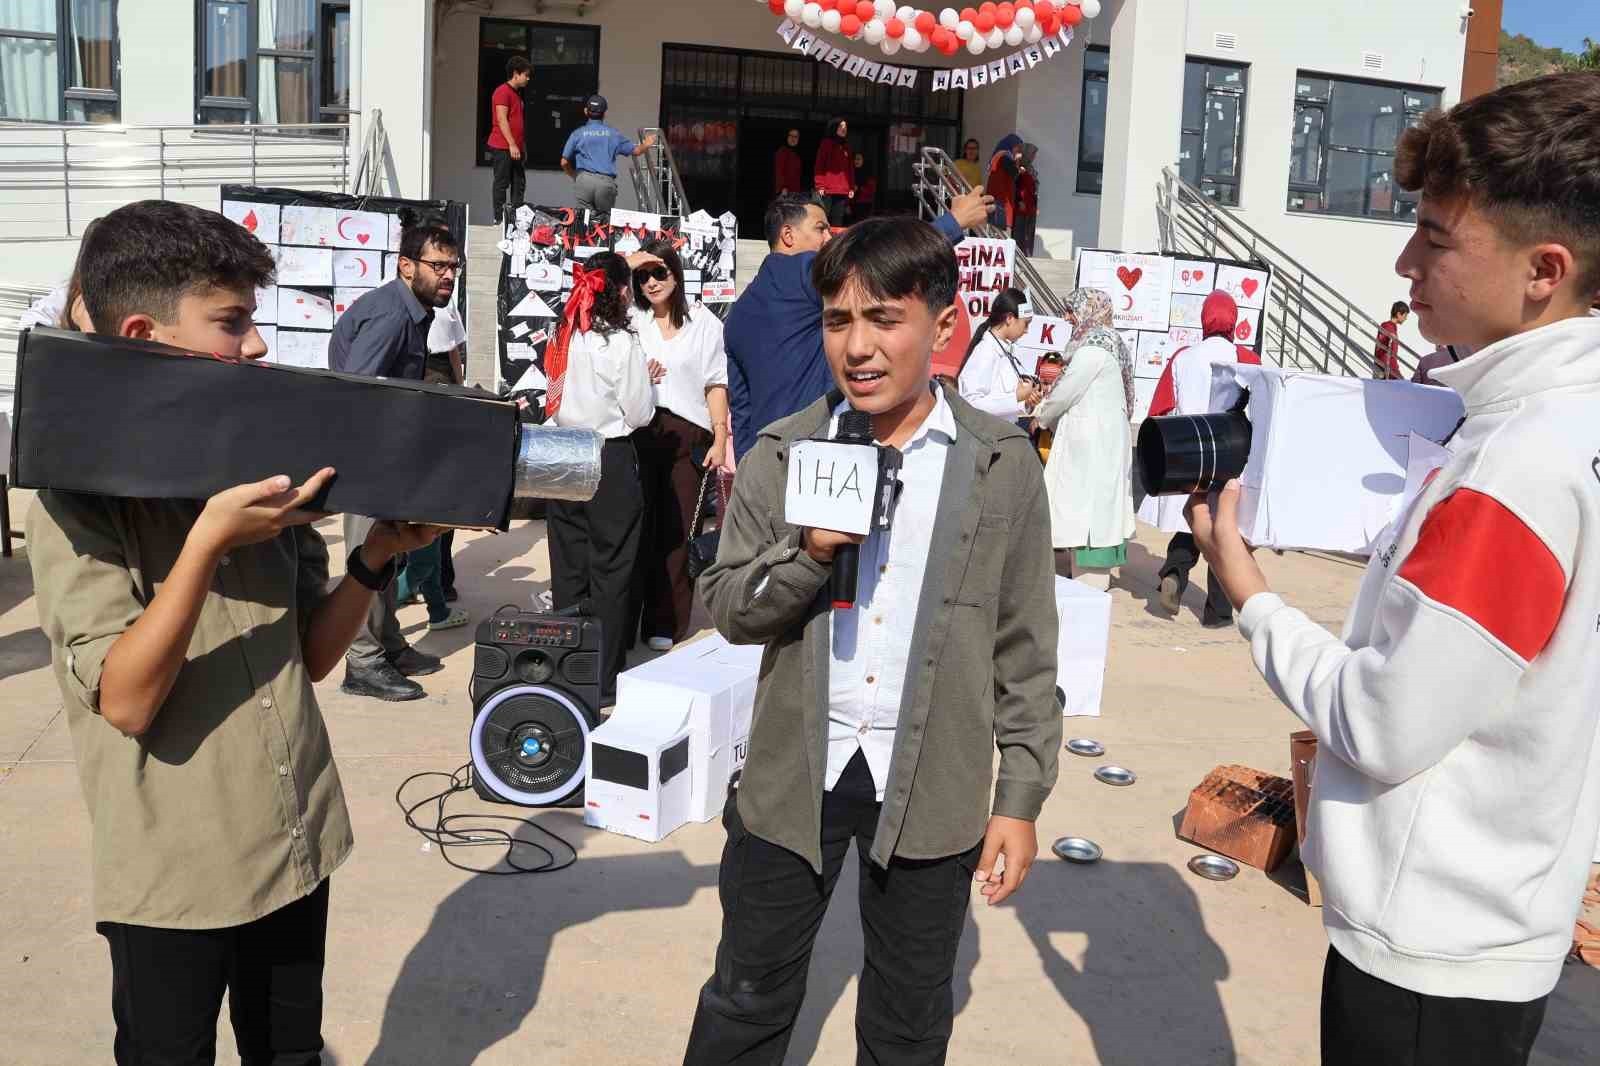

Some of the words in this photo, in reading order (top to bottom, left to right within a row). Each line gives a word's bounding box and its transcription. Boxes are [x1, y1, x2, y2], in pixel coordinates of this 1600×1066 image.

[798, 37, 912, 84] KIZILAY
[937, 40, 1055, 87] HAFTASI
[1039, 322, 1056, 345] K
